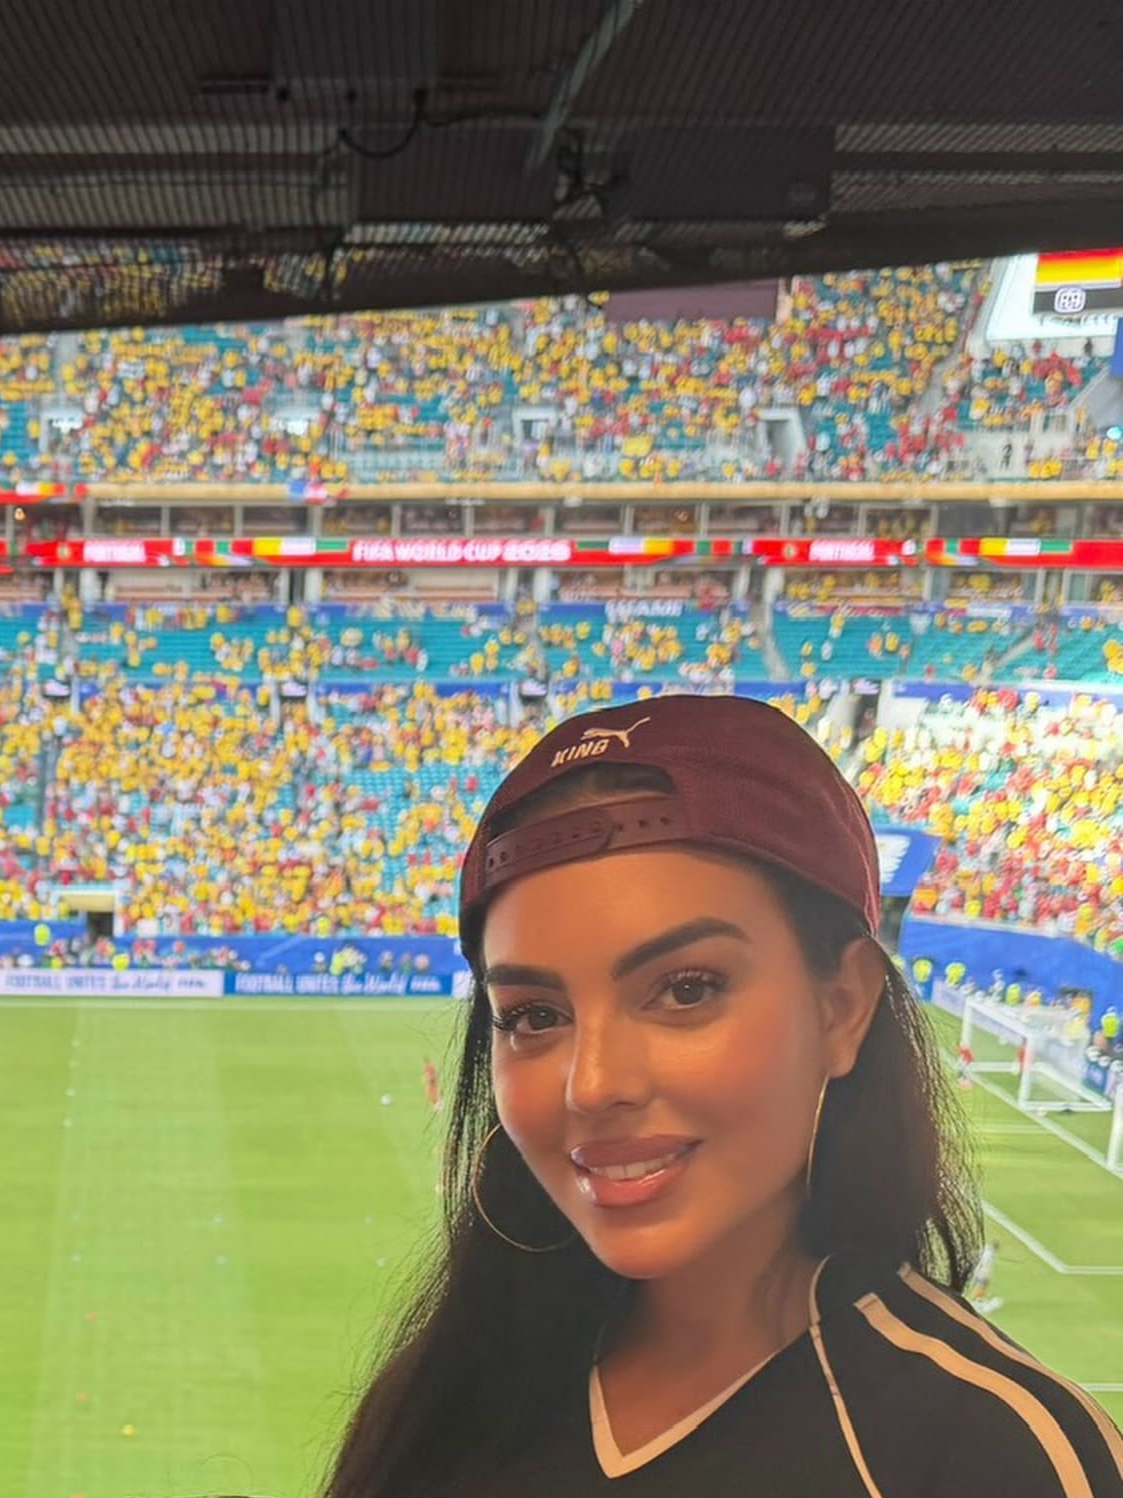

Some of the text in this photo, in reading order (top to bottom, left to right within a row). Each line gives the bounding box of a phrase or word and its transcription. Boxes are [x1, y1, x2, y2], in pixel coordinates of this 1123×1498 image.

[353, 541, 394, 561] FIFA
[395, 541, 462, 561] WORLD
[463, 541, 502, 561] CUP
[551, 739, 610, 768] KING
